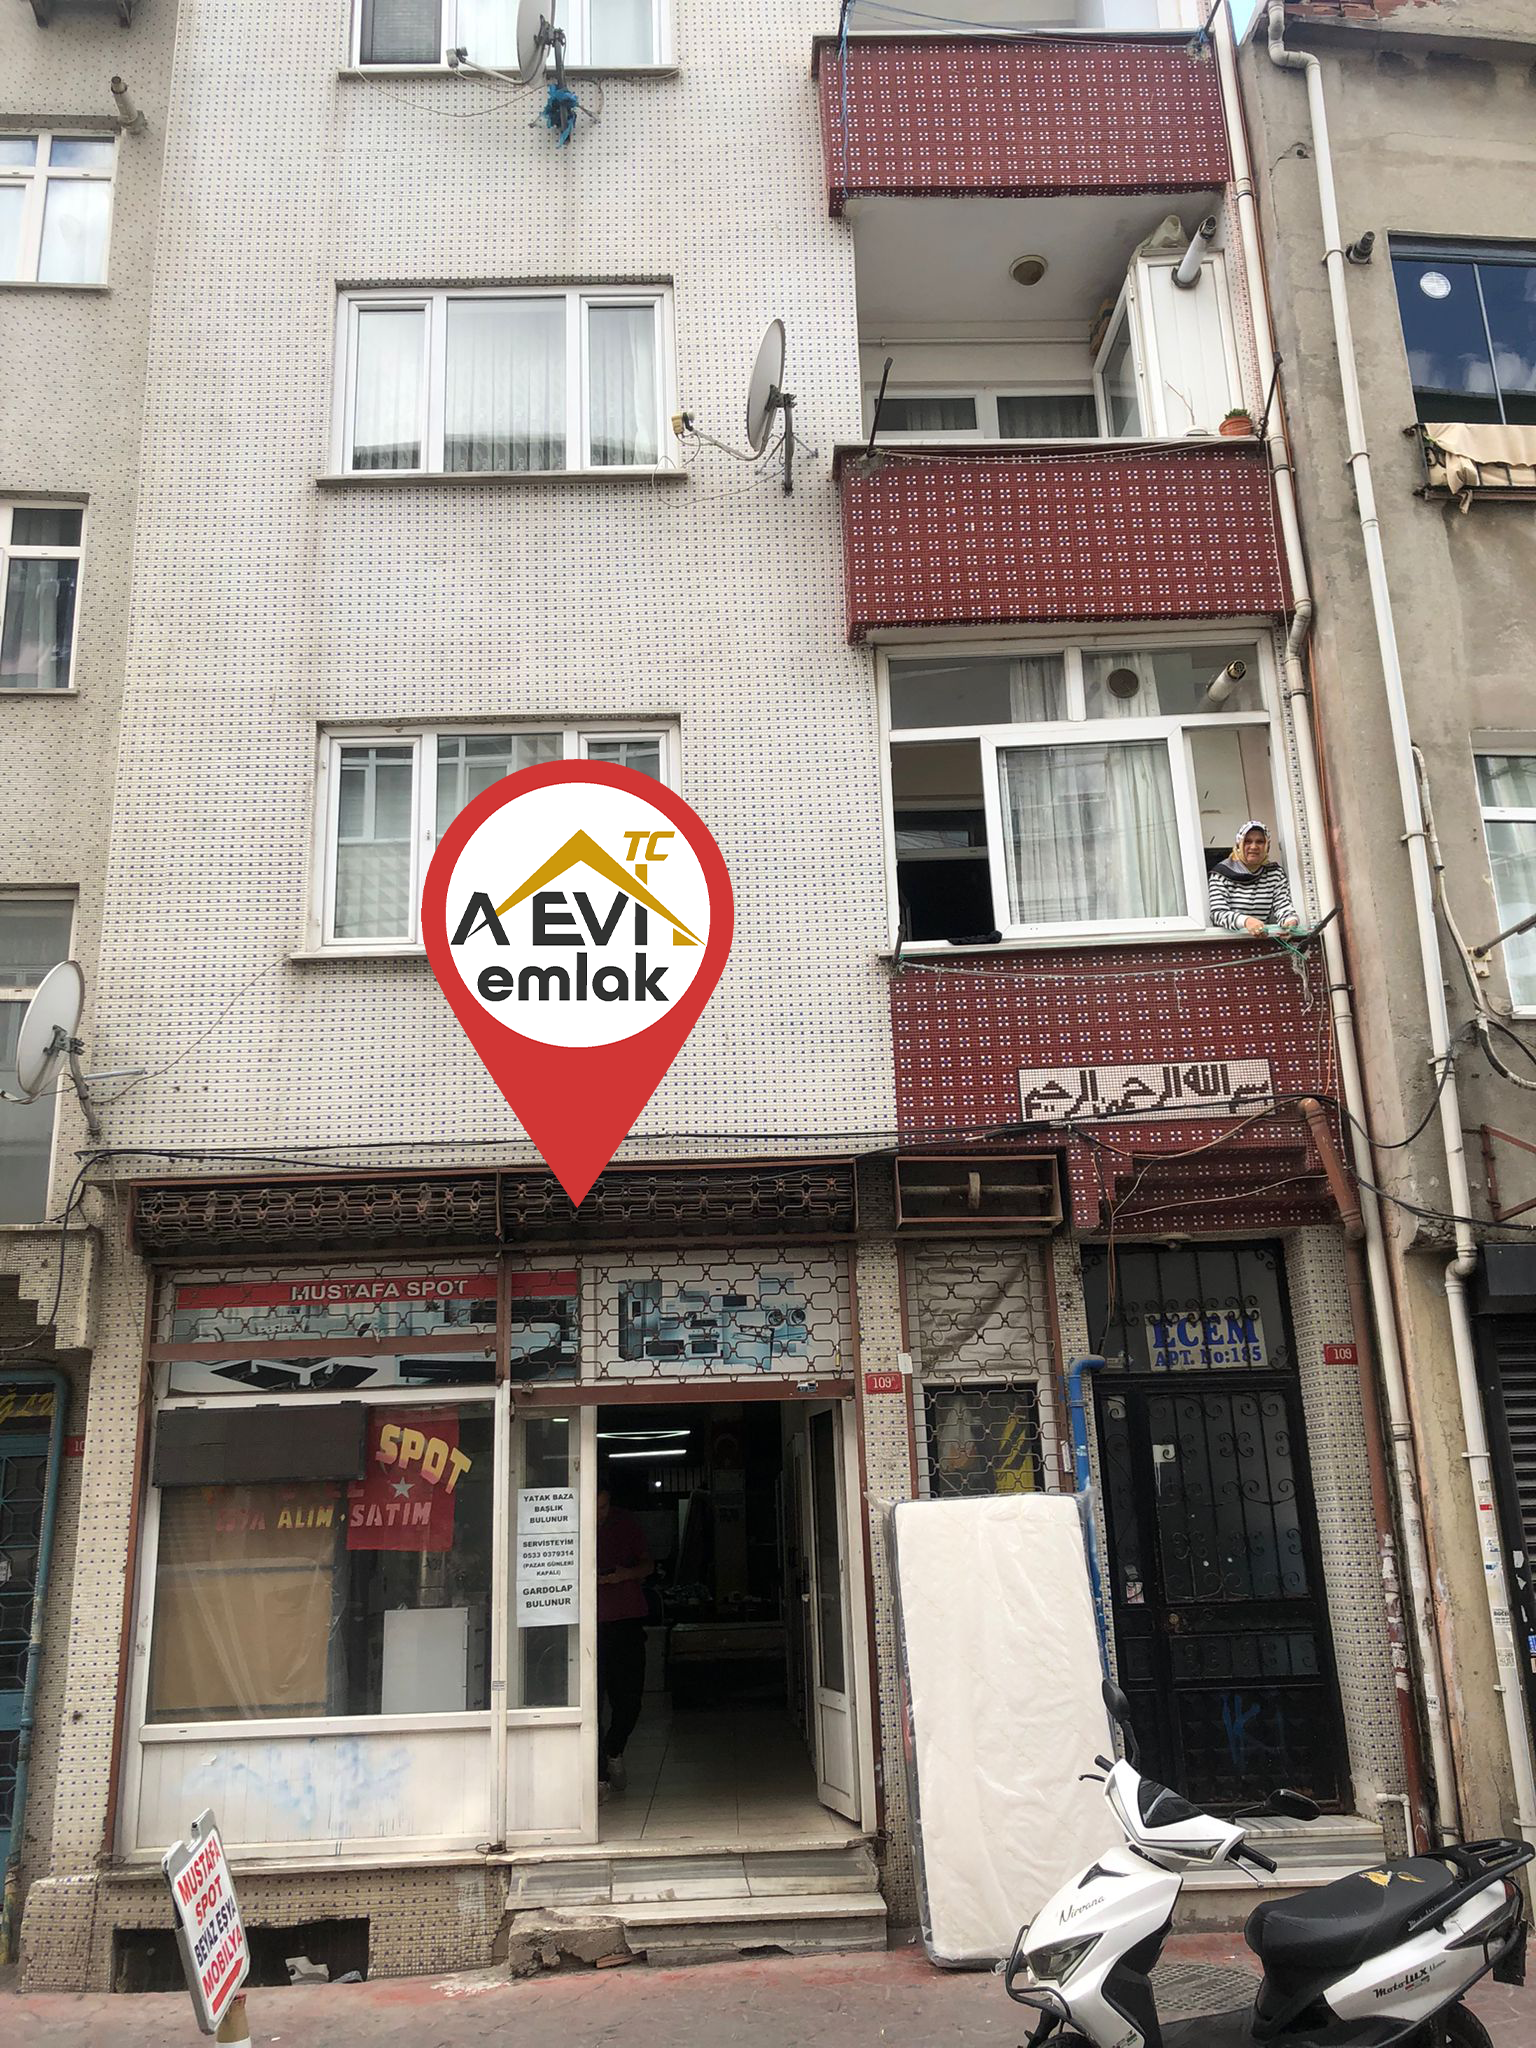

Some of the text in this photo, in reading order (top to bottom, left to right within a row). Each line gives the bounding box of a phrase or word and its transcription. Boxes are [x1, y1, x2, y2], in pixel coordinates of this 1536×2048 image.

[291, 1280, 468, 1301] MUSTAFA SPOT
[1152, 1314, 1260, 1348] ECEM
[375, 1423, 473, 1495] SPOT
[523, 1493, 574, 1503] YATAK BAZA
[534, 1504, 563, 1513] BAŞLIK
[277, 1504, 335, 1529] ALIM
[350, 1501, 432, 1528] SATIM
[529, 1515, 568, 1524] BULUNUR
[522, 1551, 541, 1559] 0533
[522, 1584, 573, 1596] GARDOLAP
[526, 1597, 571, 1609] BULUNUR
[177, 1836, 223, 1906] MUSTAFA
[195, 1874, 224, 1926] SPOT
[1059, 1895, 1105, 1926] Nirvana
[194, 1896, 237, 1968] BEYAZ EŞYA
[202, 1924, 244, 1999] MOBİLYA
